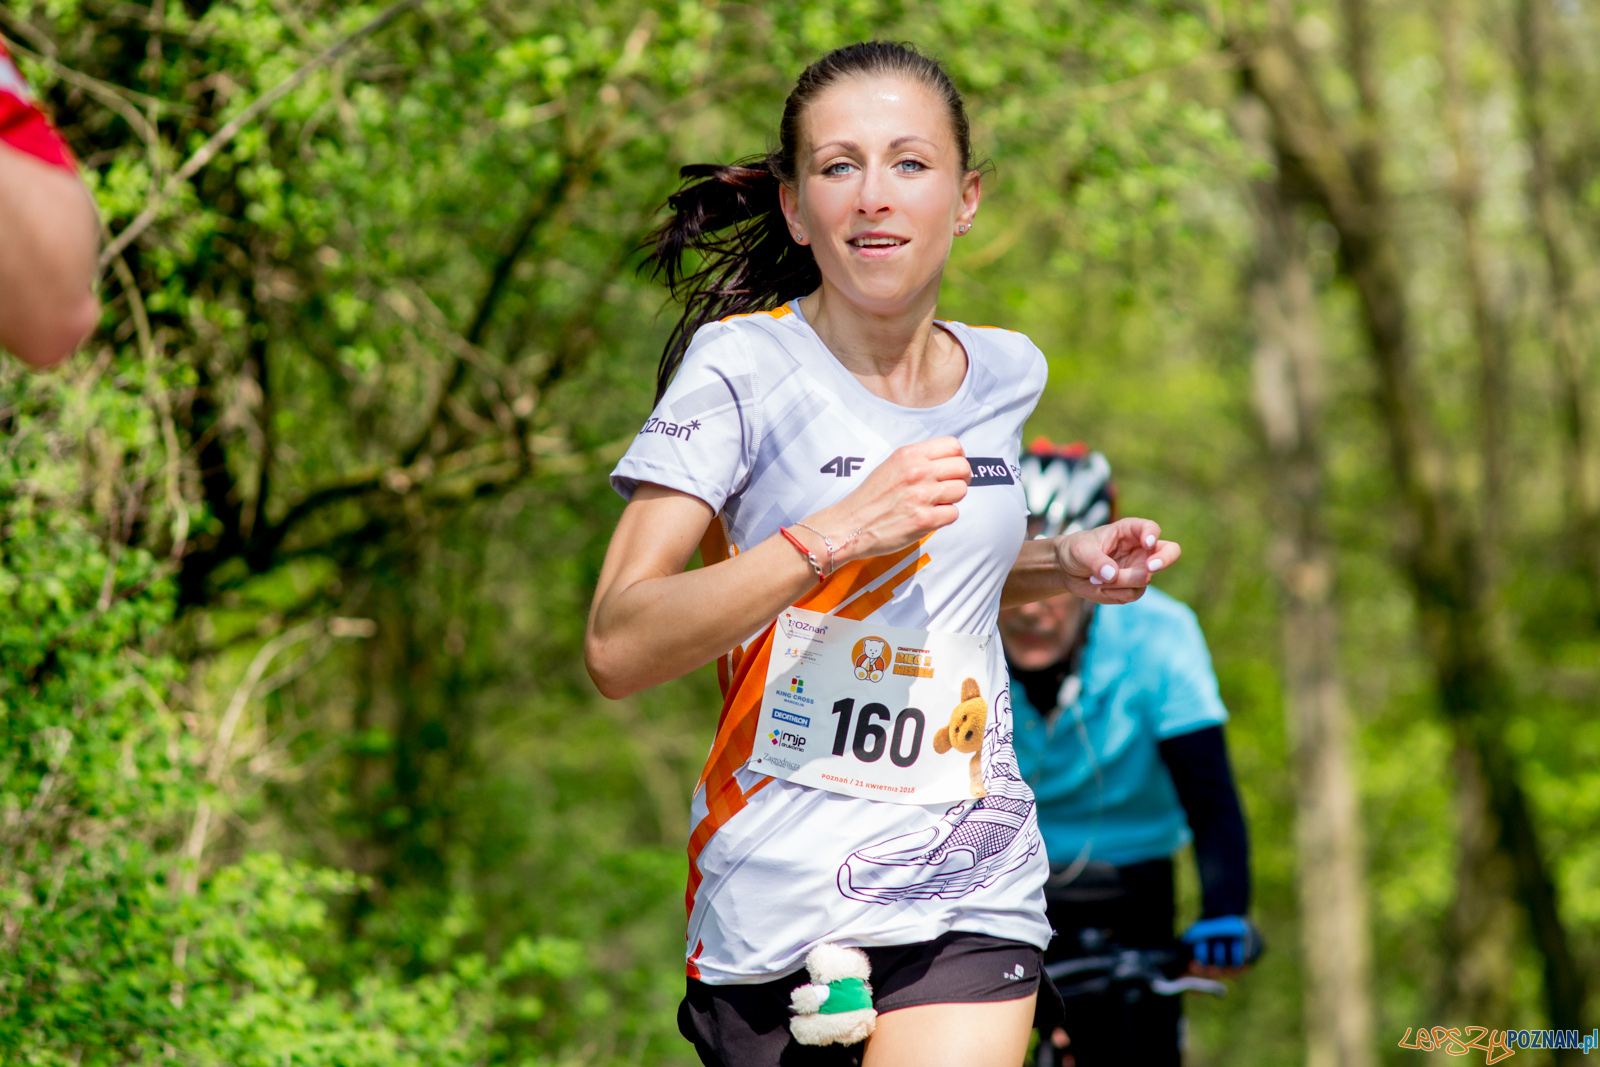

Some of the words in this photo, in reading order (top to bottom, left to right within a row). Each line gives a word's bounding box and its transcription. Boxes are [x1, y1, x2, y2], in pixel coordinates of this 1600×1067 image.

[820, 456, 865, 477] 4F
[893, 664, 935, 679] MISIEM
[776, 690, 791, 698] KING
[793, 694, 815, 705] CROSS
[773, 710, 808, 726] DECATHLON
[783, 732, 807, 747] mjp
[832, 697, 925, 768] 160
[855, 779, 864, 787] 21
[899, 786, 915, 794] 2018
